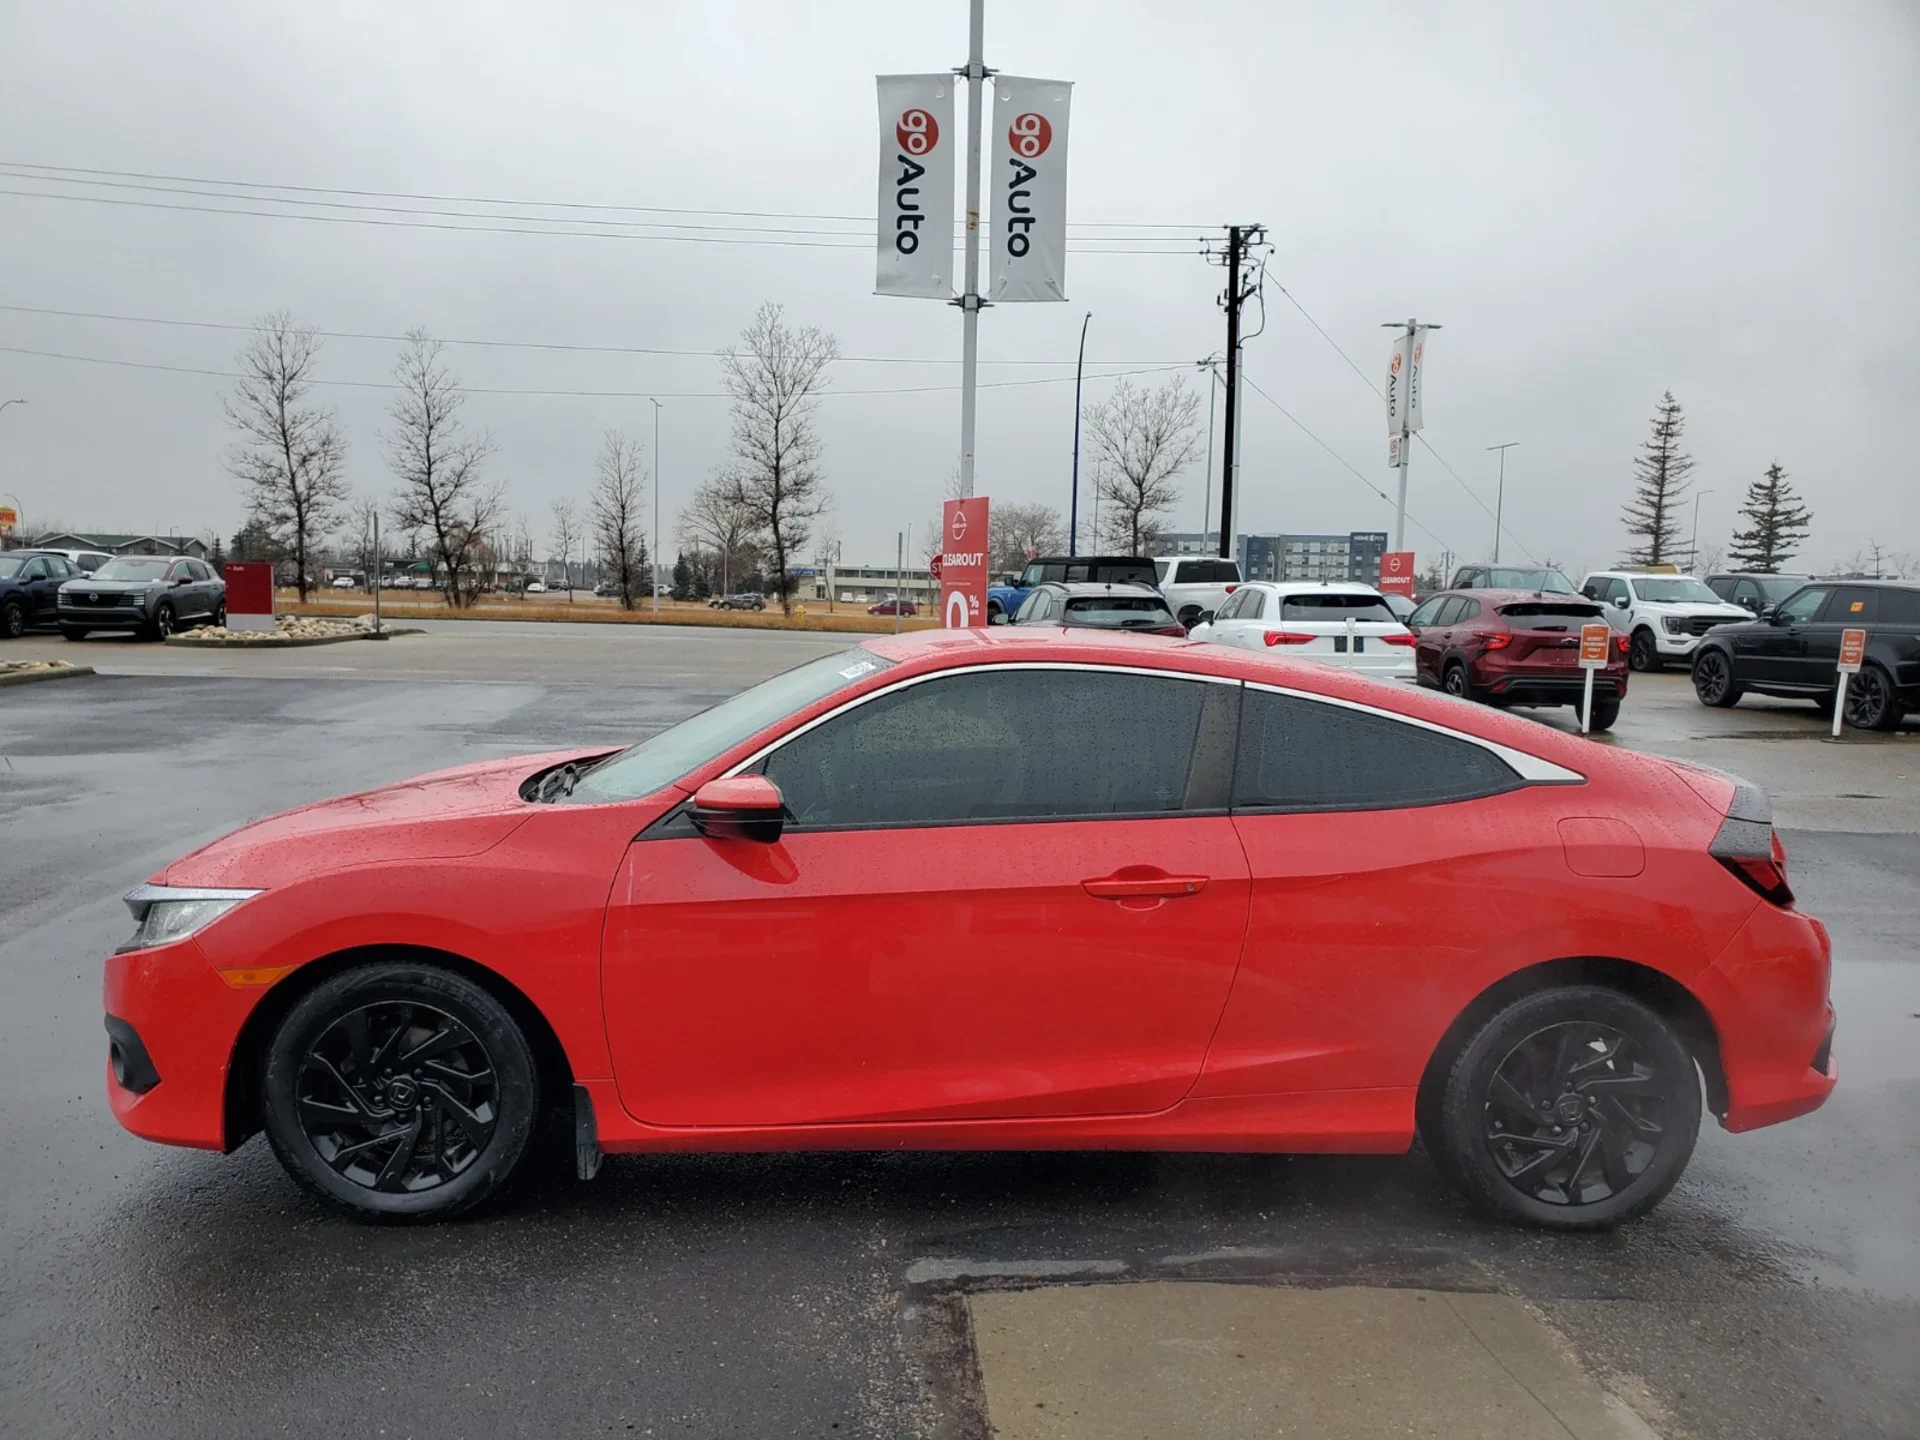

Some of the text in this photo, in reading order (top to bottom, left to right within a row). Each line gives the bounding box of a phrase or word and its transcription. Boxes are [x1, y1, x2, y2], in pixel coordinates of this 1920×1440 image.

[896, 154, 925, 255] Auto
[1007, 158, 1037, 258] Auto
[1389, 374, 1397, 417] Auto
[931, 562, 942, 573] ST
